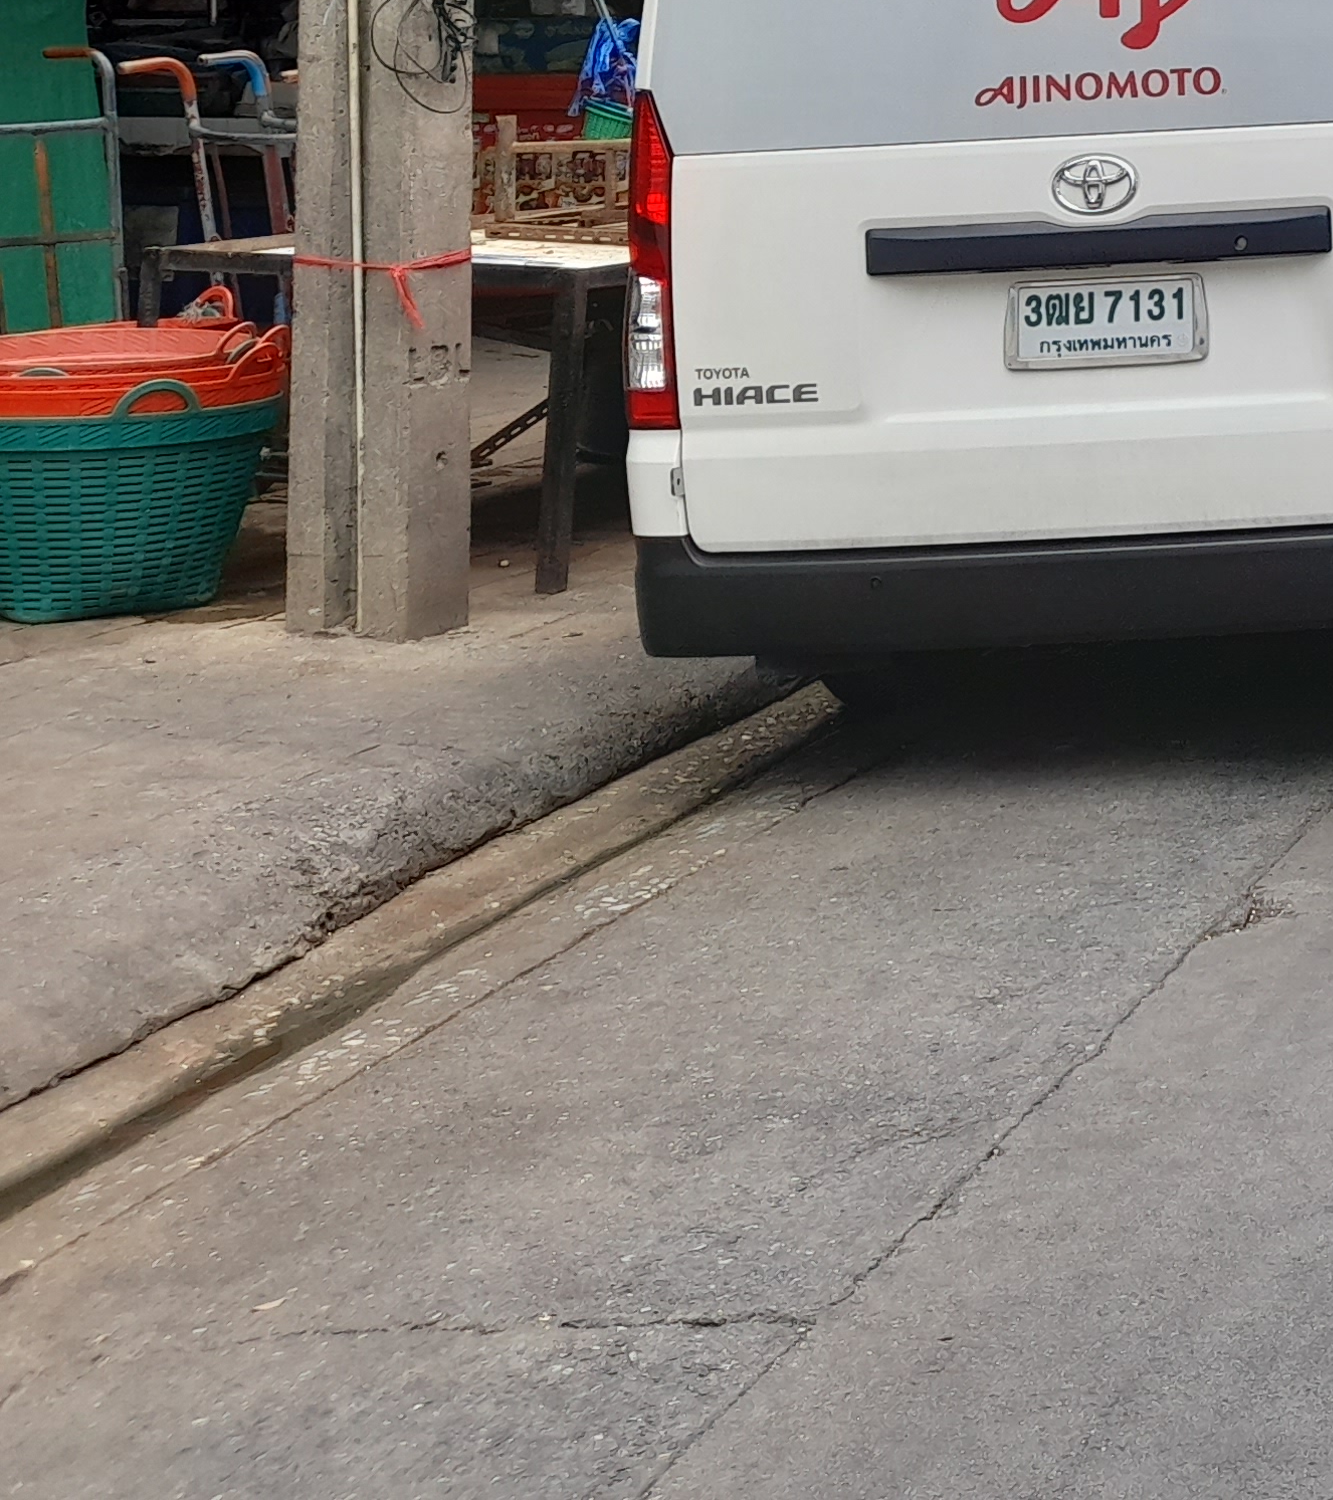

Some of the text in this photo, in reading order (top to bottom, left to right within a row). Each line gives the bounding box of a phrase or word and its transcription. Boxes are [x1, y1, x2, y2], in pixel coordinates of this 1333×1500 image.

[975, 66, 1221, 109] AJINOMOTO
[1104, 287, 1184, 323] 7131
[1040, 334, 1172, 358] กรุงเทพมหานคร
[695, 367, 750, 380] TOYOTA
[693, 383, 819, 406] HIACE
